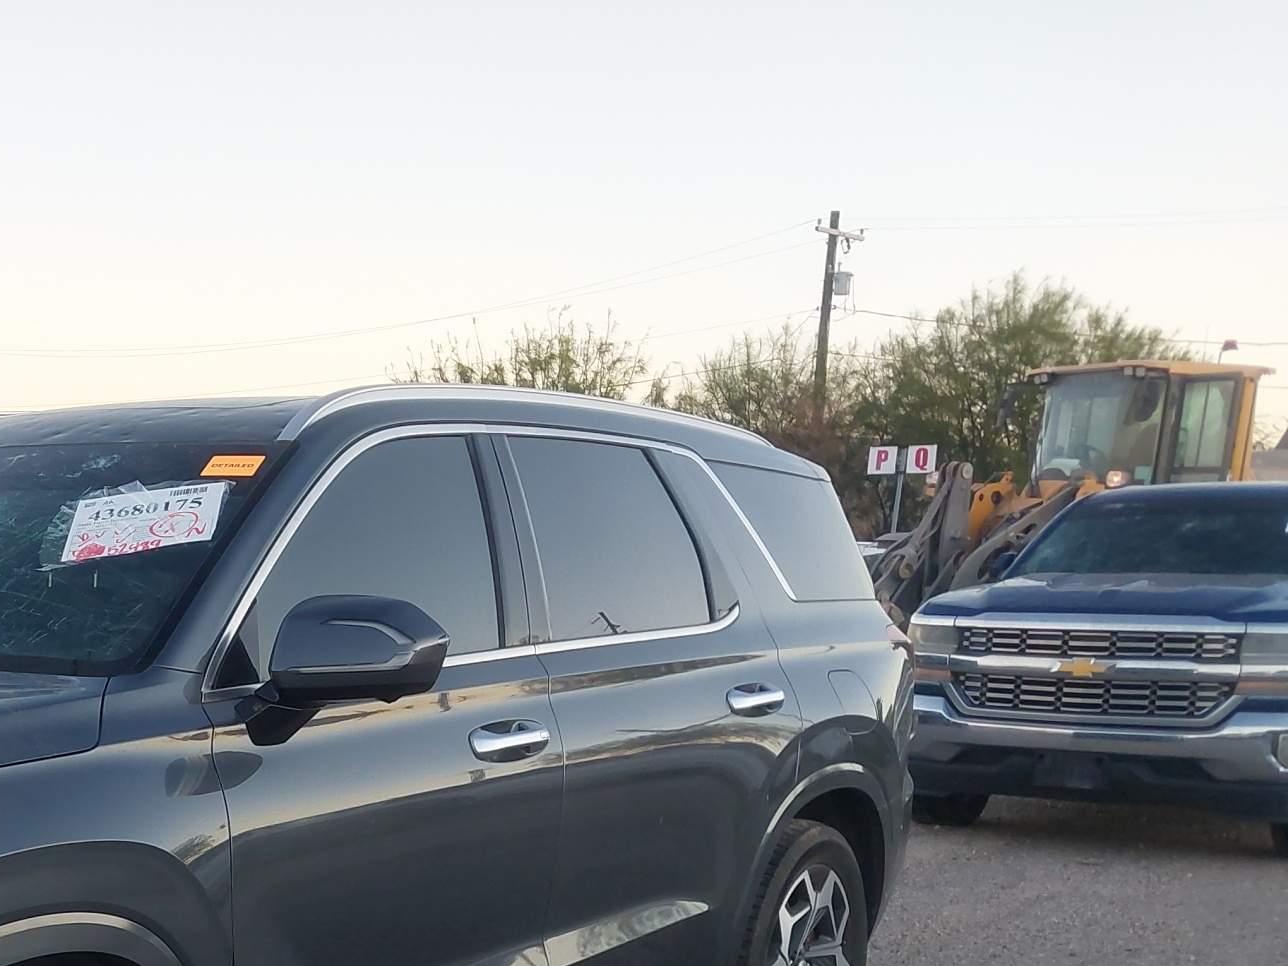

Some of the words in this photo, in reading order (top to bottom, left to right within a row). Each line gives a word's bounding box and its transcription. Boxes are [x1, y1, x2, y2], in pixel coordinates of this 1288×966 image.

[876, 450, 889, 470] P
[915, 447, 929, 470] Q
[89, 497, 203, 522] 43680175
